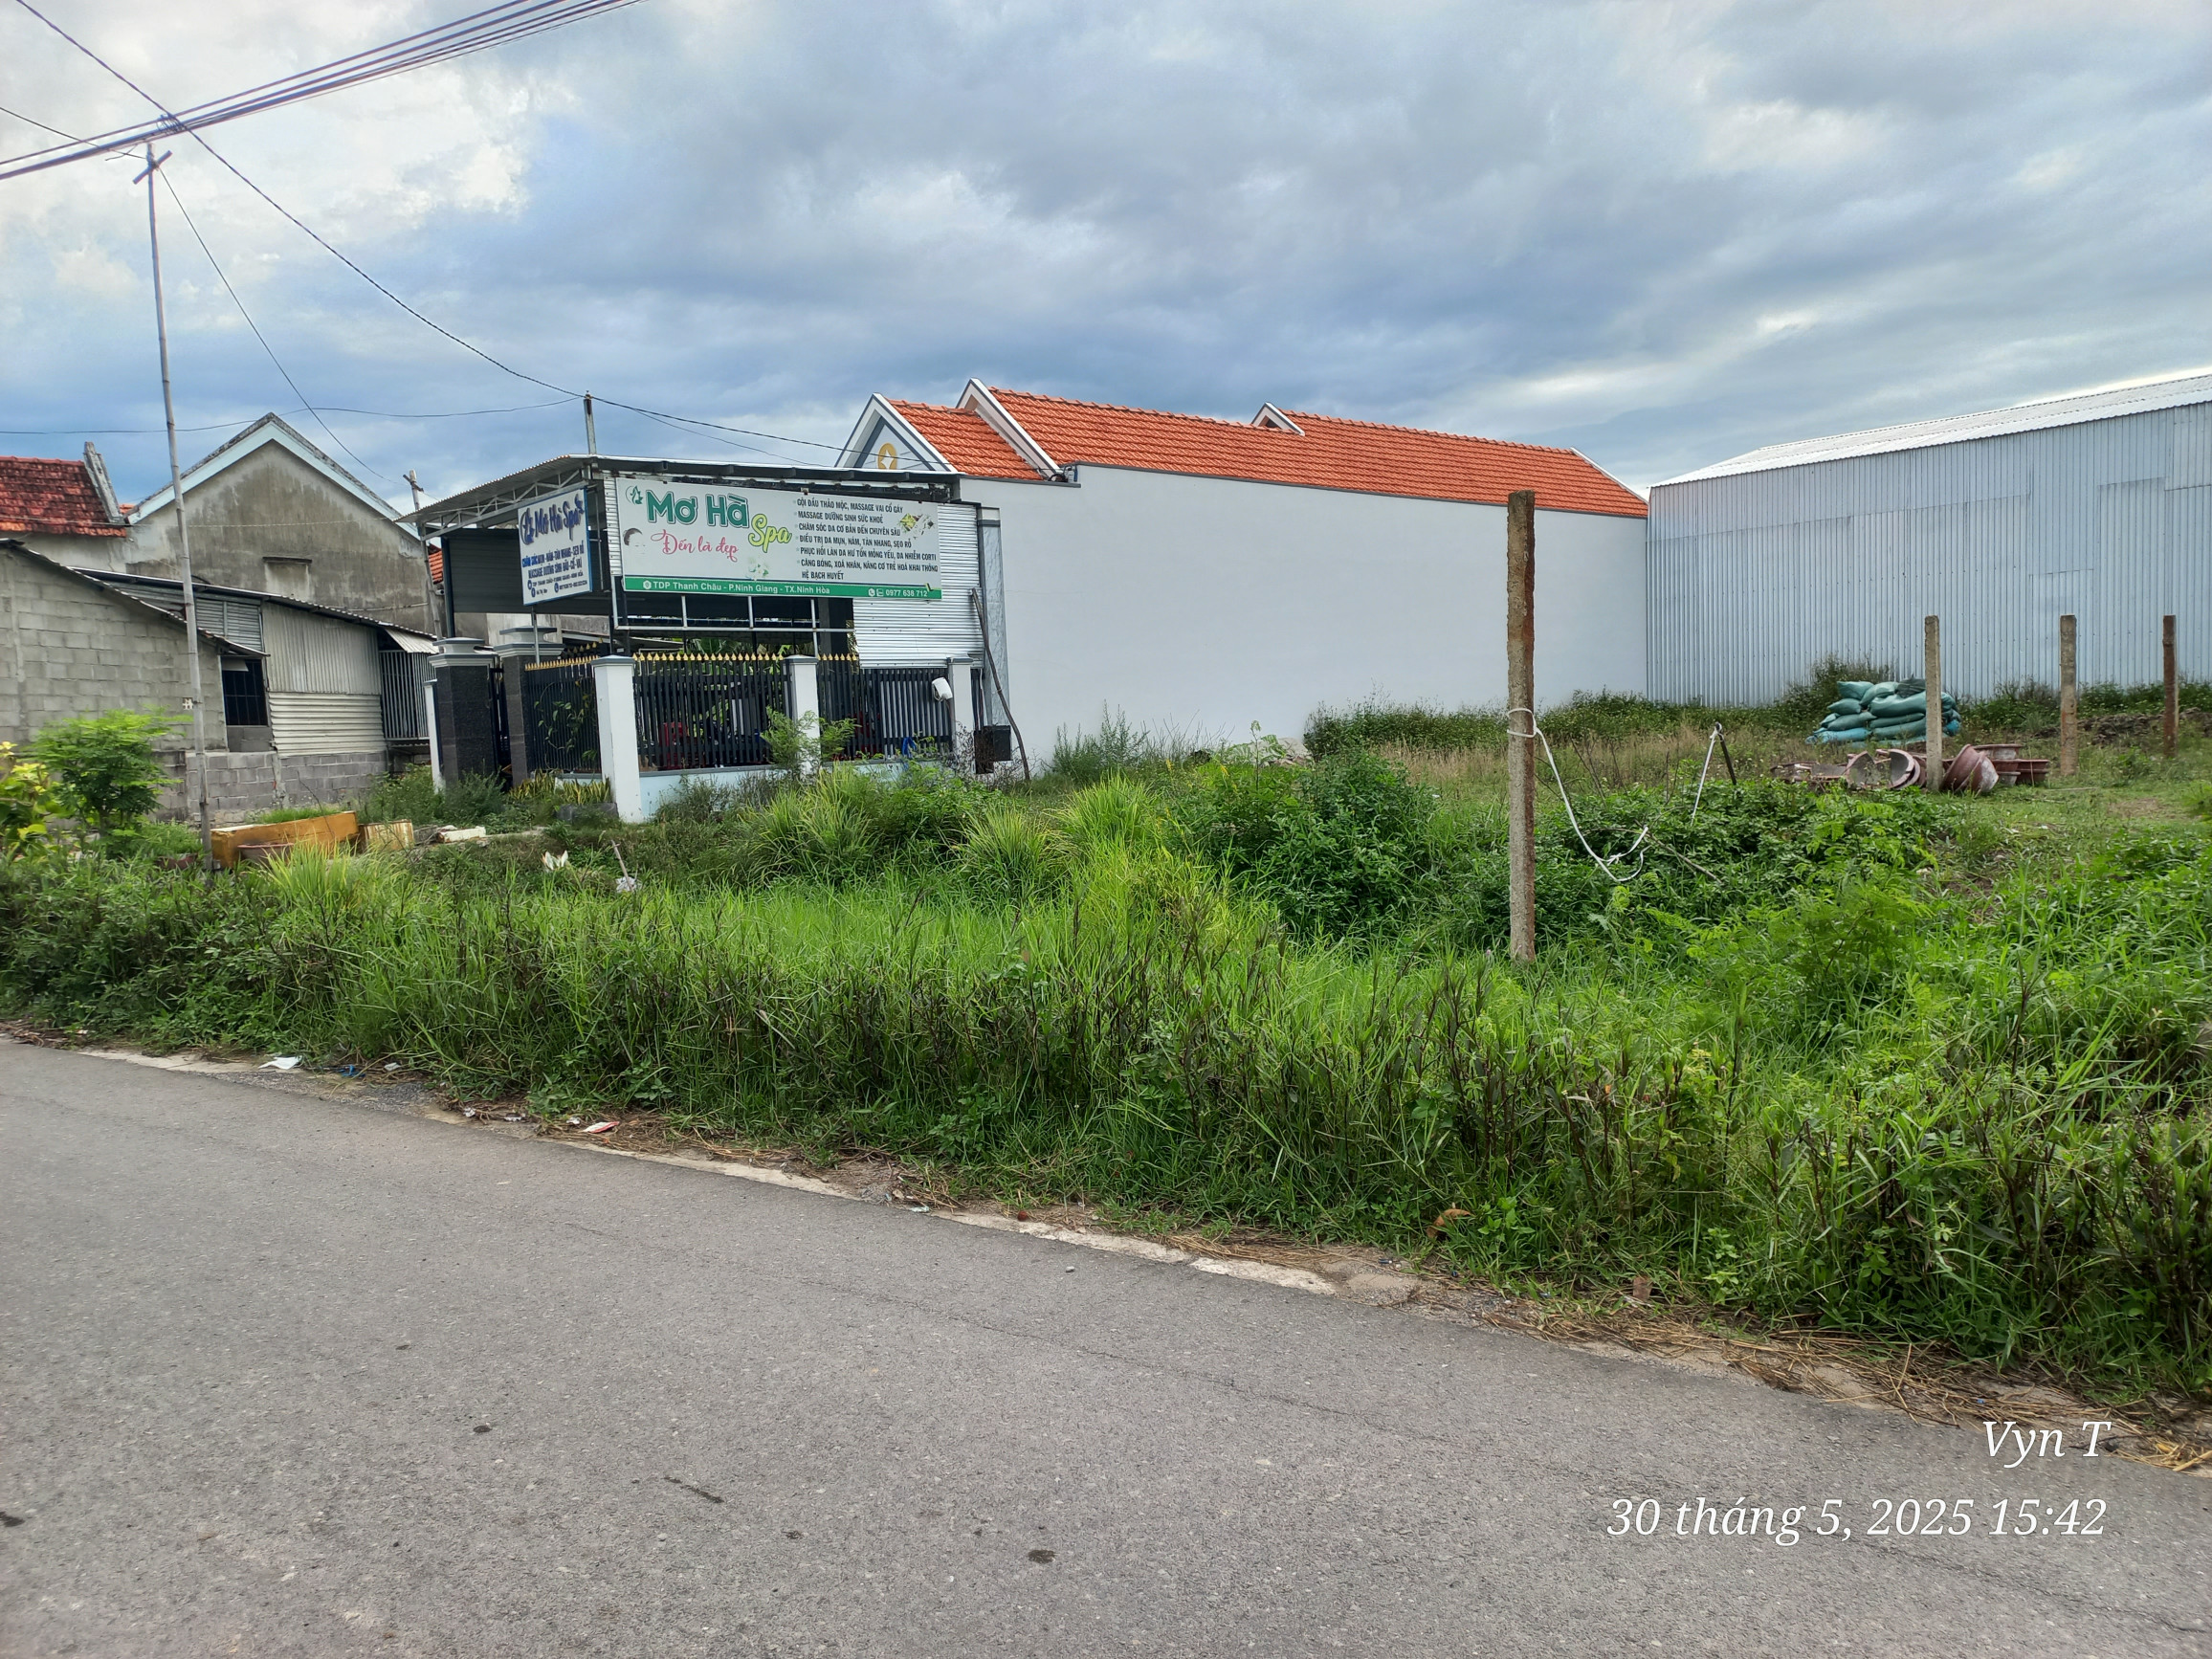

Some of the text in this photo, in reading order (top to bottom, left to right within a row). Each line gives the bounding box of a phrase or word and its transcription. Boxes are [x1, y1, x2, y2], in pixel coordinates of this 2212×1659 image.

[646, 490, 749, 528] Mơ Hà
[798, 511, 823, 520] MASSAGE
[651, 529, 739, 563] Đến là đẹp
[748, 514, 792, 553] Spa
[701, 582, 721, 590] Châu
[816, 586, 830, 594] Hòa
